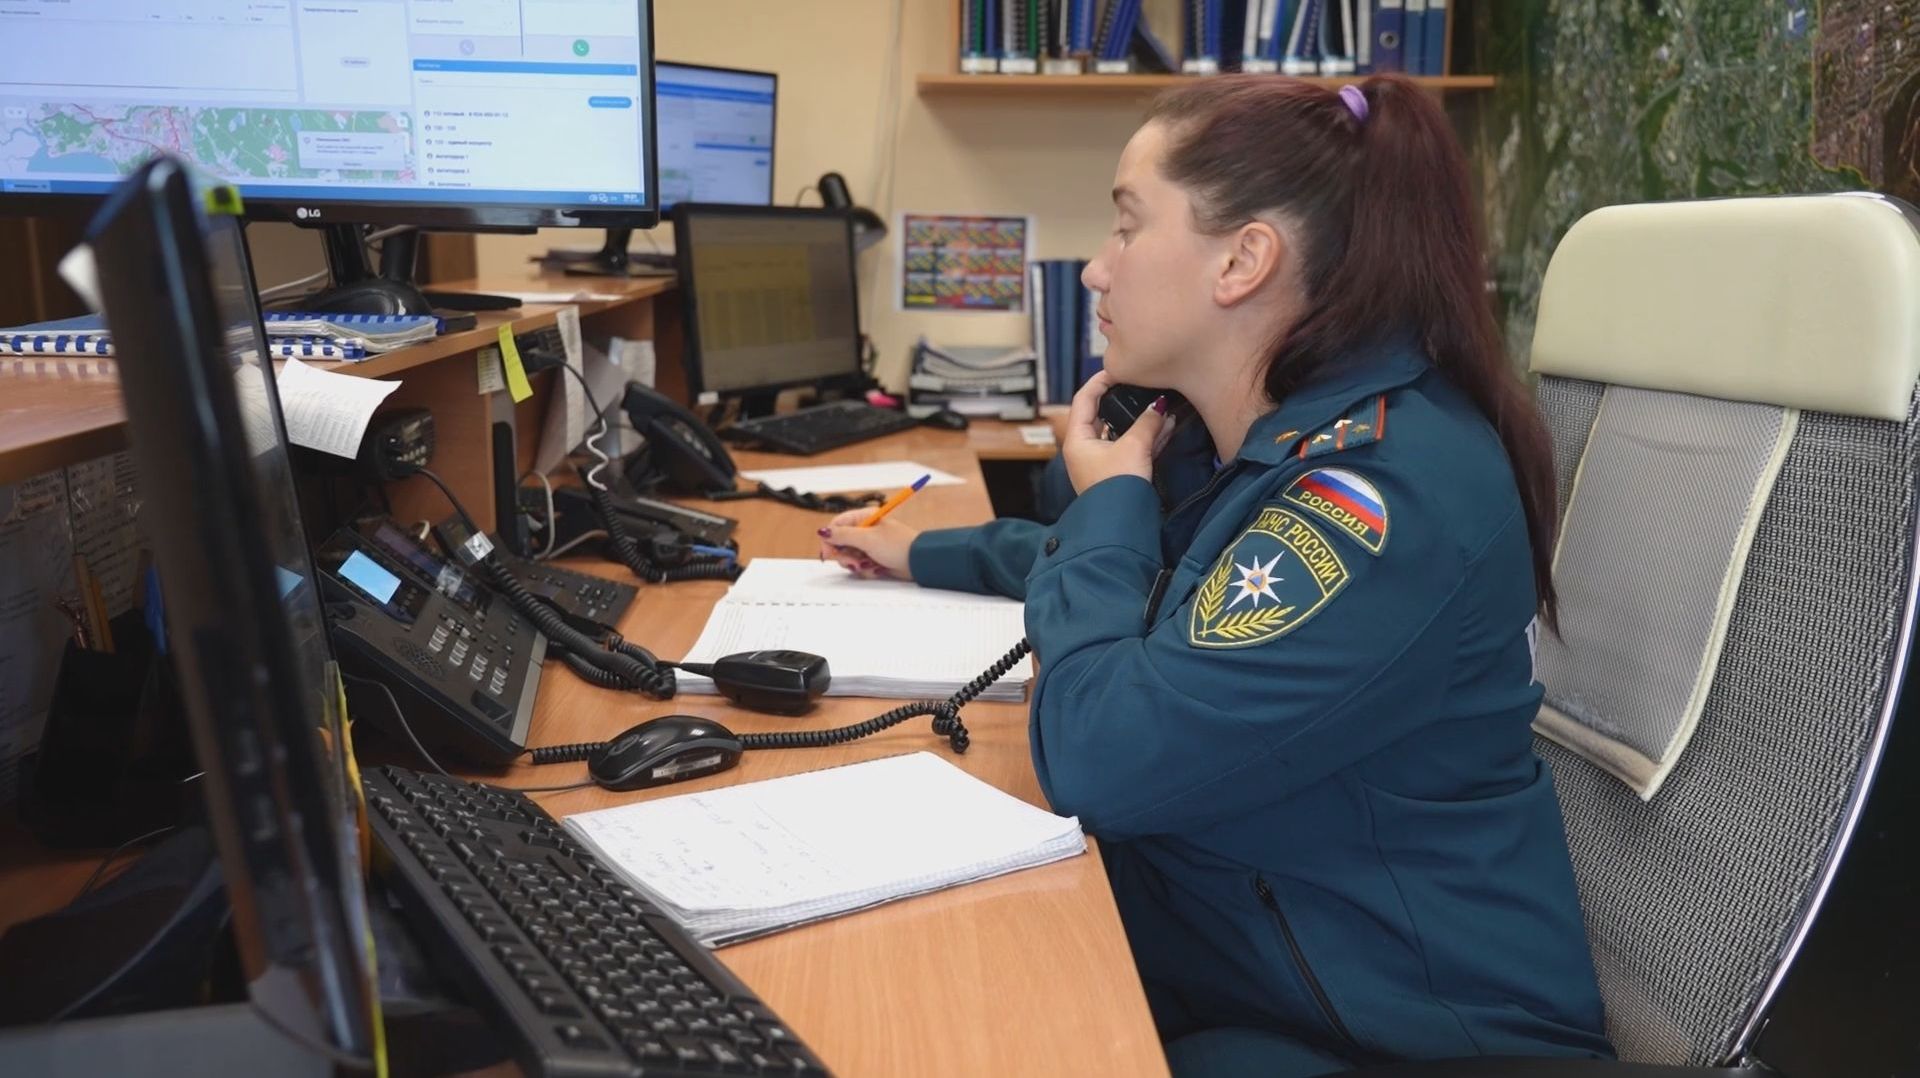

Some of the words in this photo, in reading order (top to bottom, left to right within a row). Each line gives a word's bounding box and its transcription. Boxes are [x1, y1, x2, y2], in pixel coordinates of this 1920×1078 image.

[308, 208, 321, 218] LG
[1297, 490, 1370, 536] РОССИЯ
[1283, 523, 1340, 585] РОССИИ
